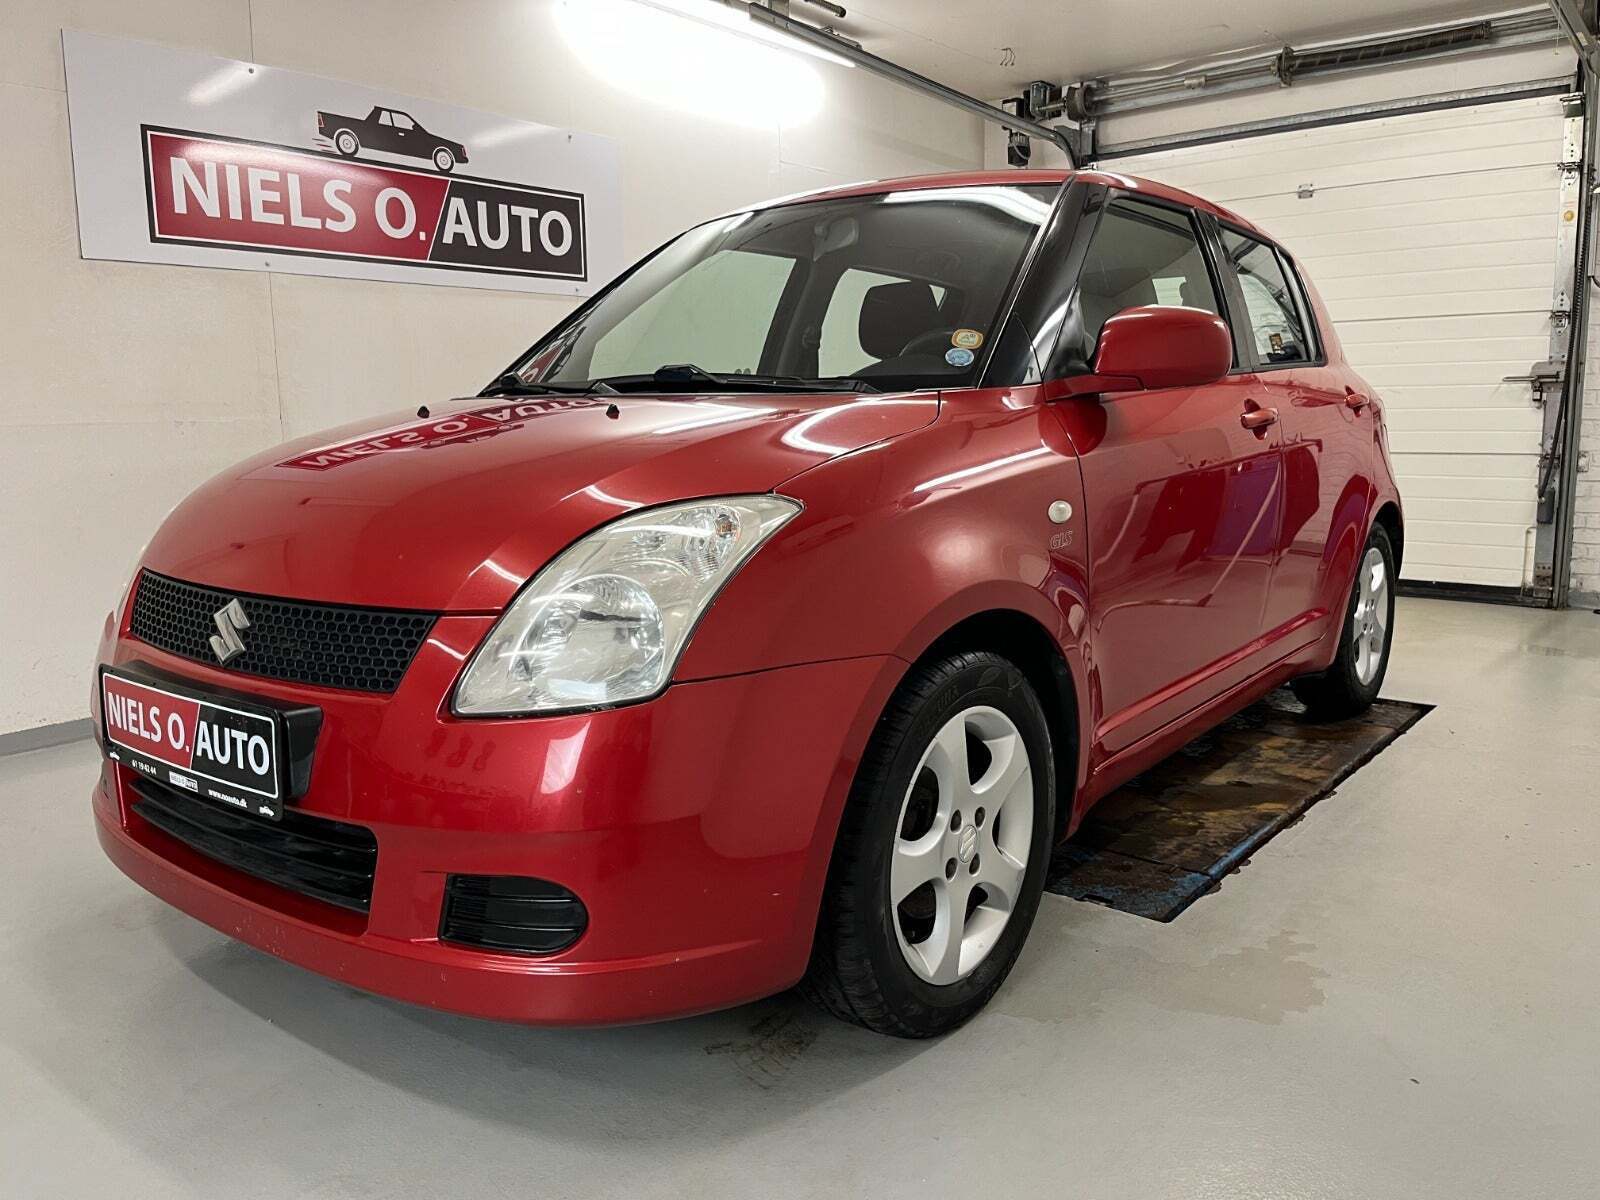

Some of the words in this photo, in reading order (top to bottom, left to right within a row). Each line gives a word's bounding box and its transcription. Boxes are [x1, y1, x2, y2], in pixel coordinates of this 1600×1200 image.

[170, 156, 358, 234] NIELS
[374, 187, 427, 241] O.
[441, 196, 573, 257] AUTO
[1050, 531, 1073, 549] GLS
[107, 691, 162, 743] NIELS
[167, 712, 190, 753] O.
[196, 720, 270, 776] AUTO
